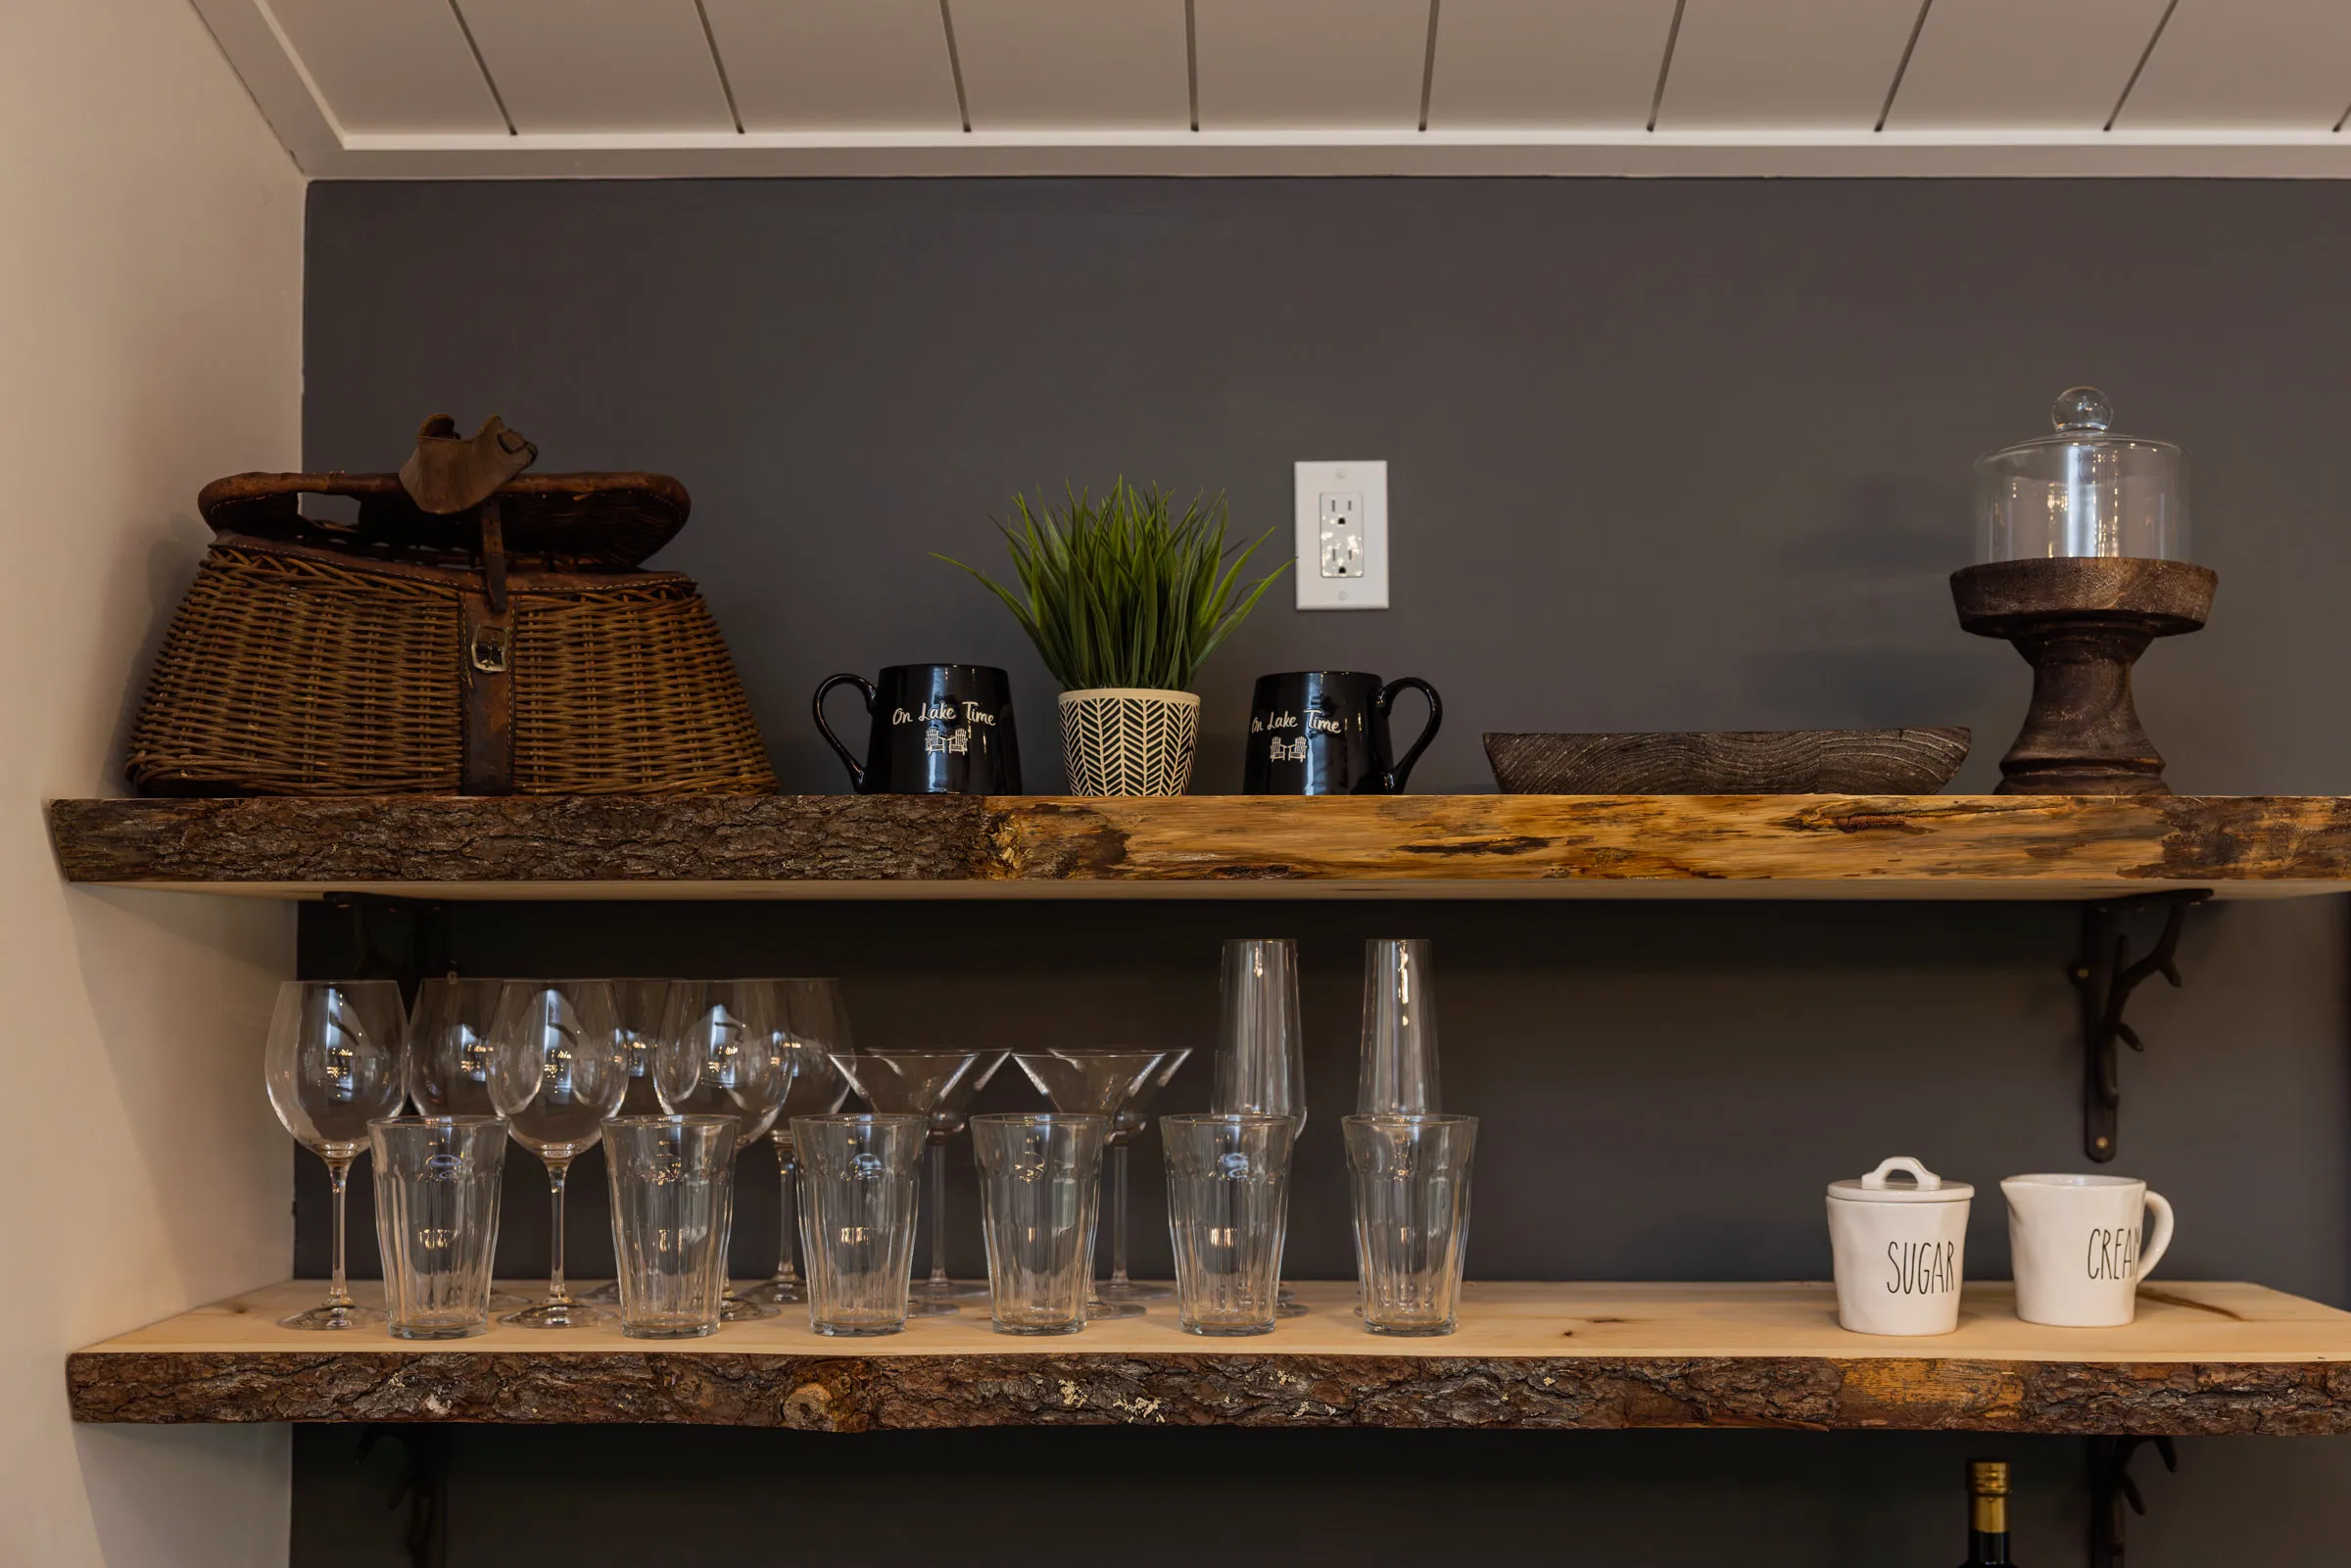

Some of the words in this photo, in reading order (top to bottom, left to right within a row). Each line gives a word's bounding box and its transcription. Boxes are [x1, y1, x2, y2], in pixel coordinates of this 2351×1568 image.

[892, 707, 913, 726] On
[918, 702, 956, 722] Lake
[962, 700, 996, 726] Time
[1251, 716, 1264, 734] On
[1267, 710, 1298, 731] Lake
[1303, 708, 1341, 734] Time
[1887, 1240, 1954, 1295] SUGAR
